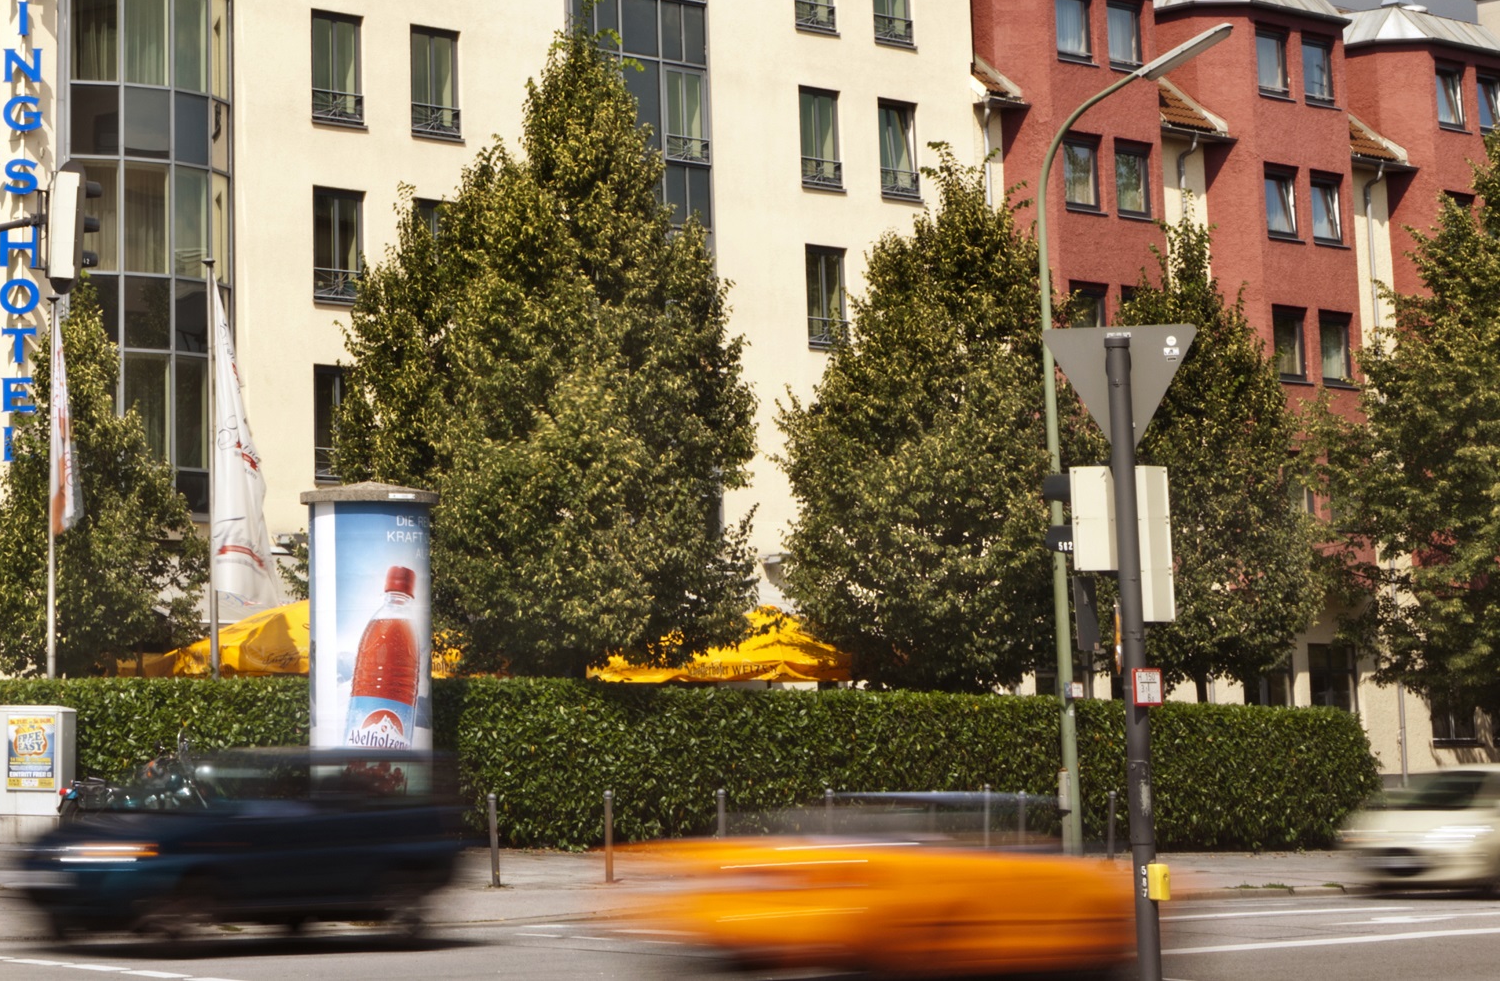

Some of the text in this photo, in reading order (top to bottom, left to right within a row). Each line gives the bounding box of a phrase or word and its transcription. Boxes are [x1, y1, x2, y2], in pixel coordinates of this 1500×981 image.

[396, 515, 415, 527] DIE
[386, 531, 423, 543] KRAFT
[18, 730, 42, 741] FREE
[348, 729, 411, 750] Adelholzen
[18, 741, 43, 751] EASY
